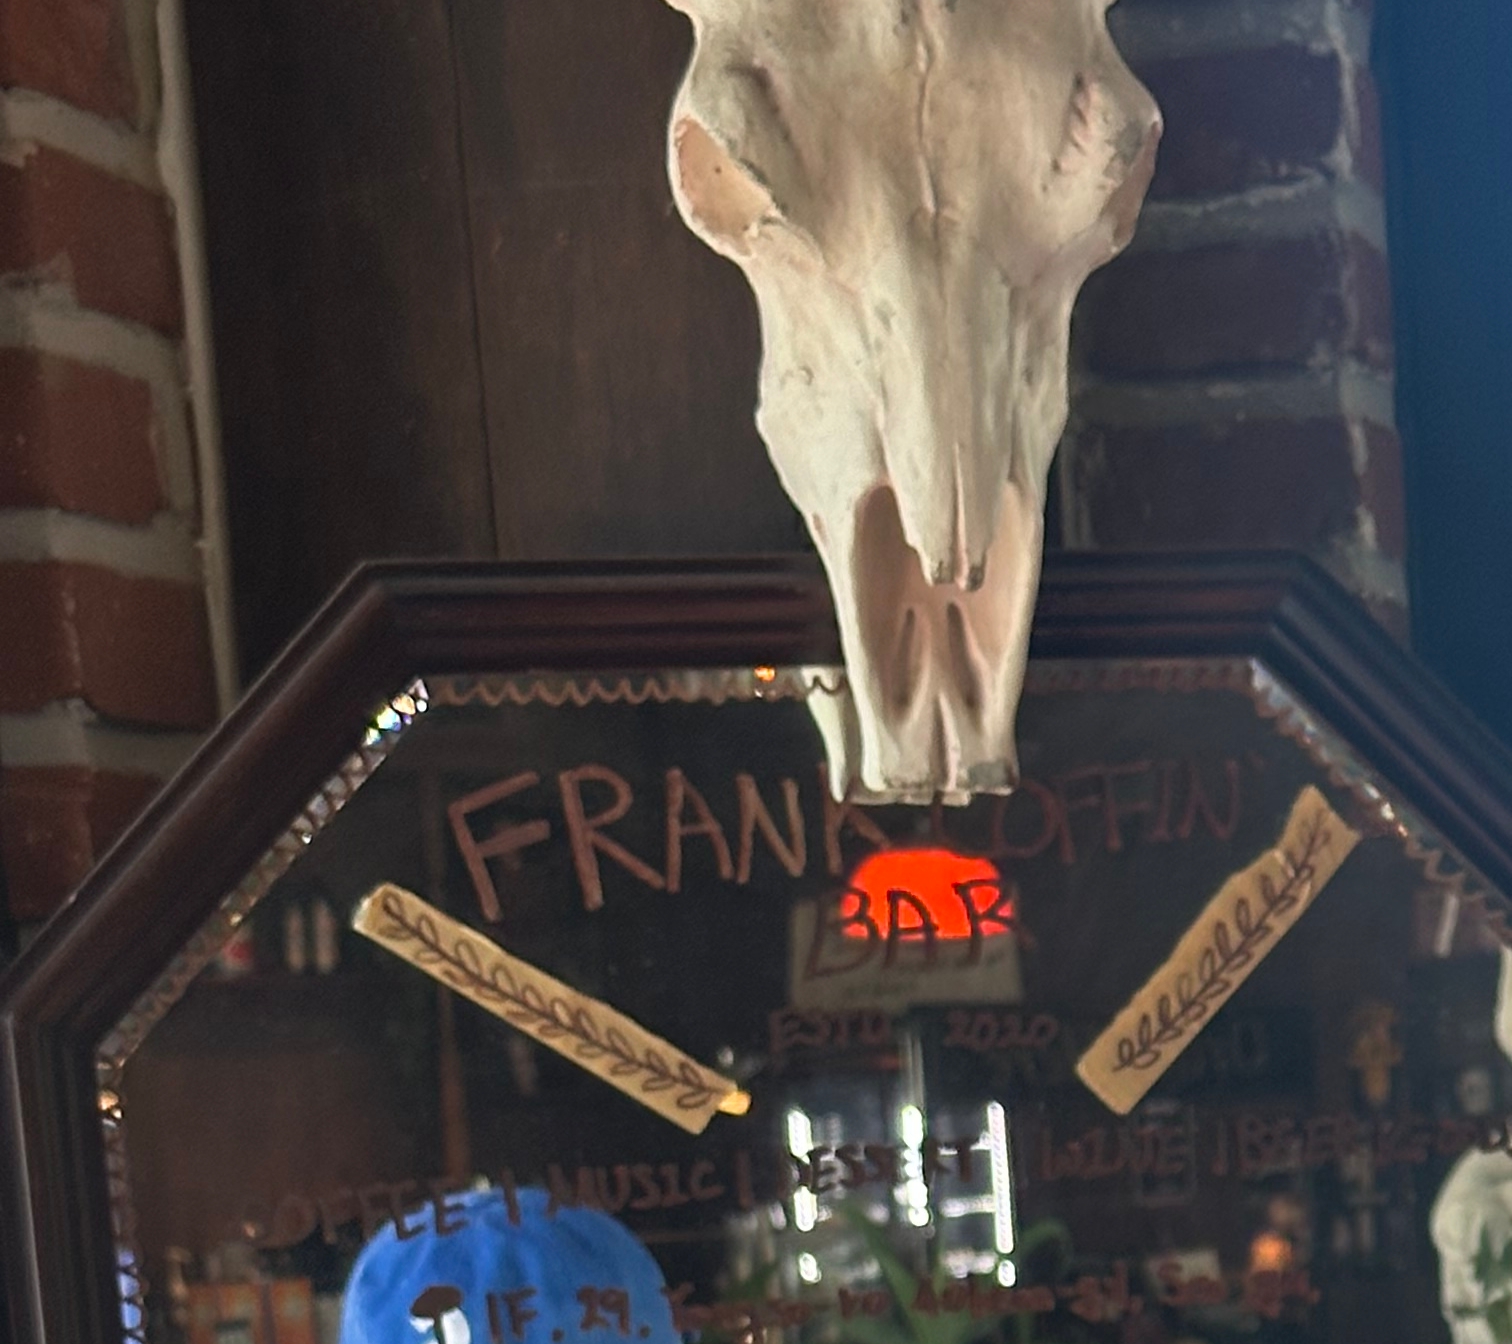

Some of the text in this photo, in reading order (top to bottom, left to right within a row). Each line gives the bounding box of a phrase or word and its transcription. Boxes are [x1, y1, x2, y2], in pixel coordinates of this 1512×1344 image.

[447, 765, 889, 921] FRANK
[802, 881, 1038, 981] BAR
[944, 1010, 1059, 1051] 2020
[546, 1158, 723, 1219] MUSIC
